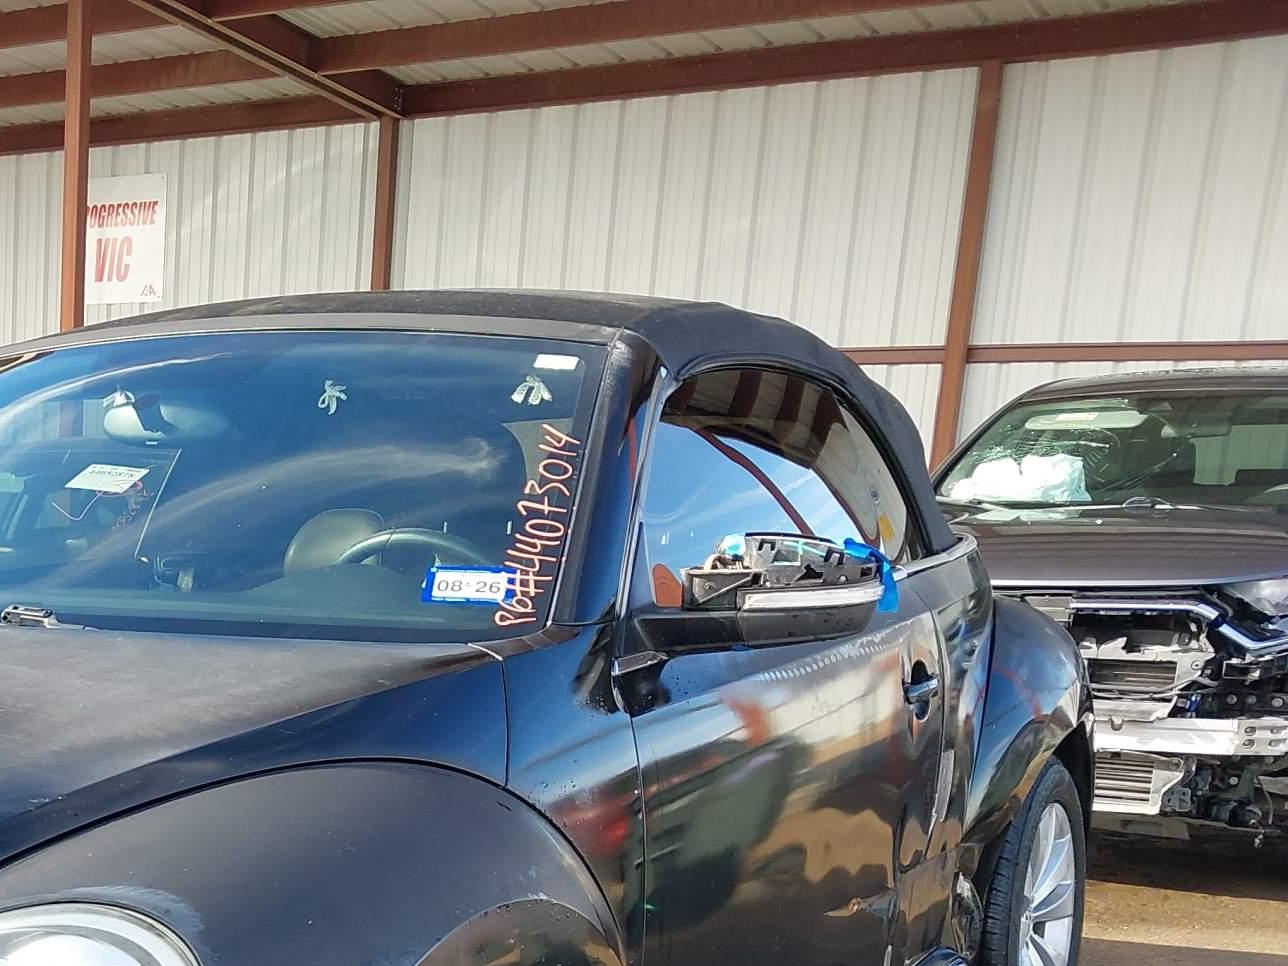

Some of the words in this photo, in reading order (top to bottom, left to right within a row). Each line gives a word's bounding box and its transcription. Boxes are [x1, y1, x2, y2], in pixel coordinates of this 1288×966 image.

[94, 236, 134, 283] VIC
[436, 579, 463, 593] 08
[474, 580, 502, 594] 26
